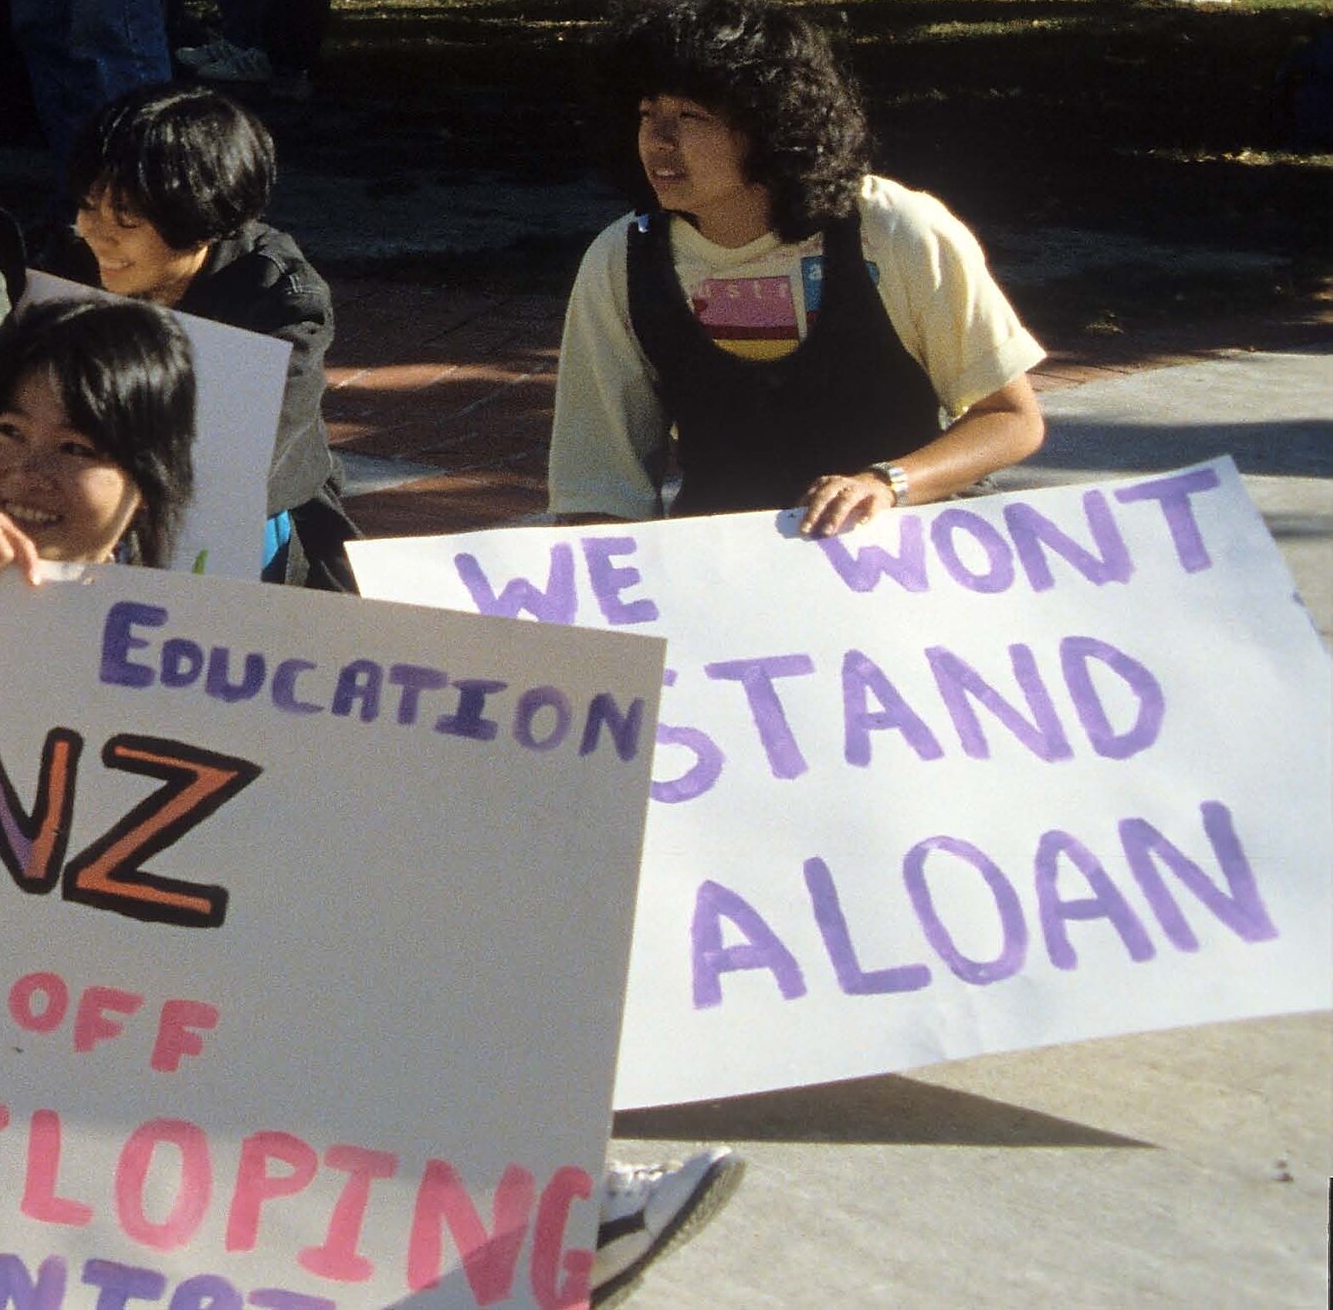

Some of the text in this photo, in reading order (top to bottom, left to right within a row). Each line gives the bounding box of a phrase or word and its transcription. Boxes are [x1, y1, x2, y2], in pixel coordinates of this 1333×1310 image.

[454, 467, 1223, 626] WE WONT
[99, 600, 646, 763] EDUCATION
[649, 635, 1166, 804] STAND
[7, 971, 220, 1073] OFF
